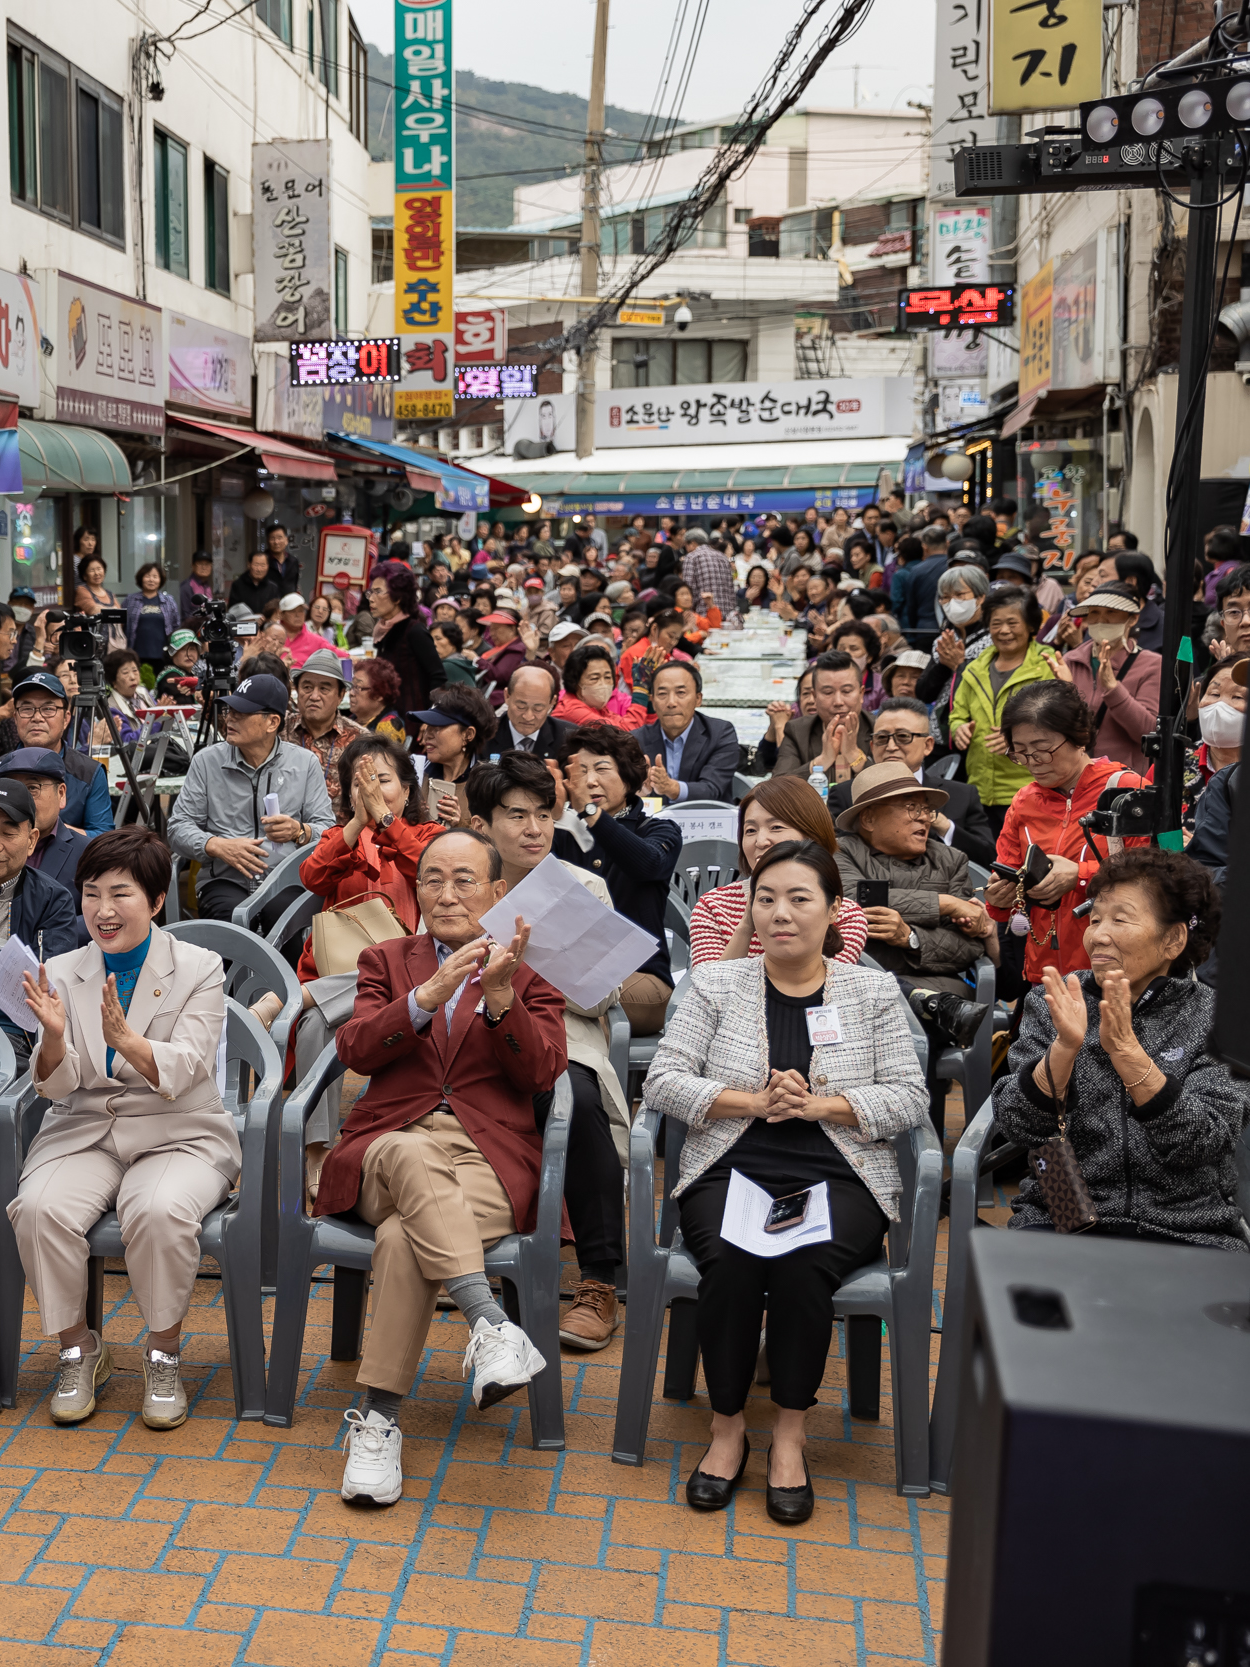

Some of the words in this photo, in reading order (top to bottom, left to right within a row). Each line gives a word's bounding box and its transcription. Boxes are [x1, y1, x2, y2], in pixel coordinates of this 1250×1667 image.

[401, 9, 449, 176] 매일사우나
[403, 278, 442, 326] 수산
[455, 312, 506, 361] 회
[625, 402, 675, 425] 소문난
